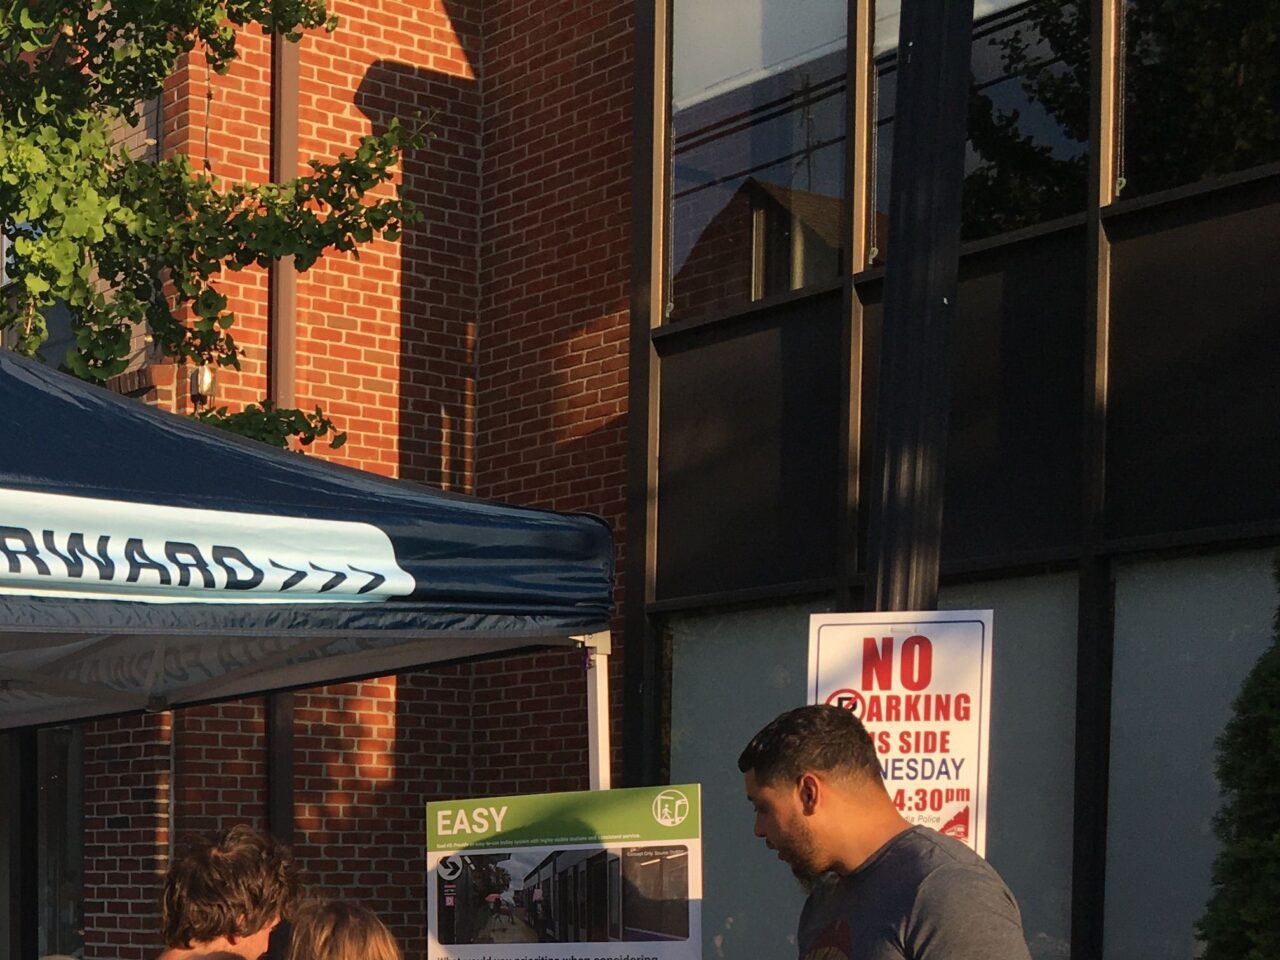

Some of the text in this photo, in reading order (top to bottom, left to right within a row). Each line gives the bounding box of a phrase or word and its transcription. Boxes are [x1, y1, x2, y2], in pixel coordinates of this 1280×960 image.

[861, 635, 933, 691] NO
[899, 731, 950, 754] SIDE
[880, 758, 965, 780] NESDAY
[437, 806, 508, 836] EASY
[917, 814, 941, 823] Police
